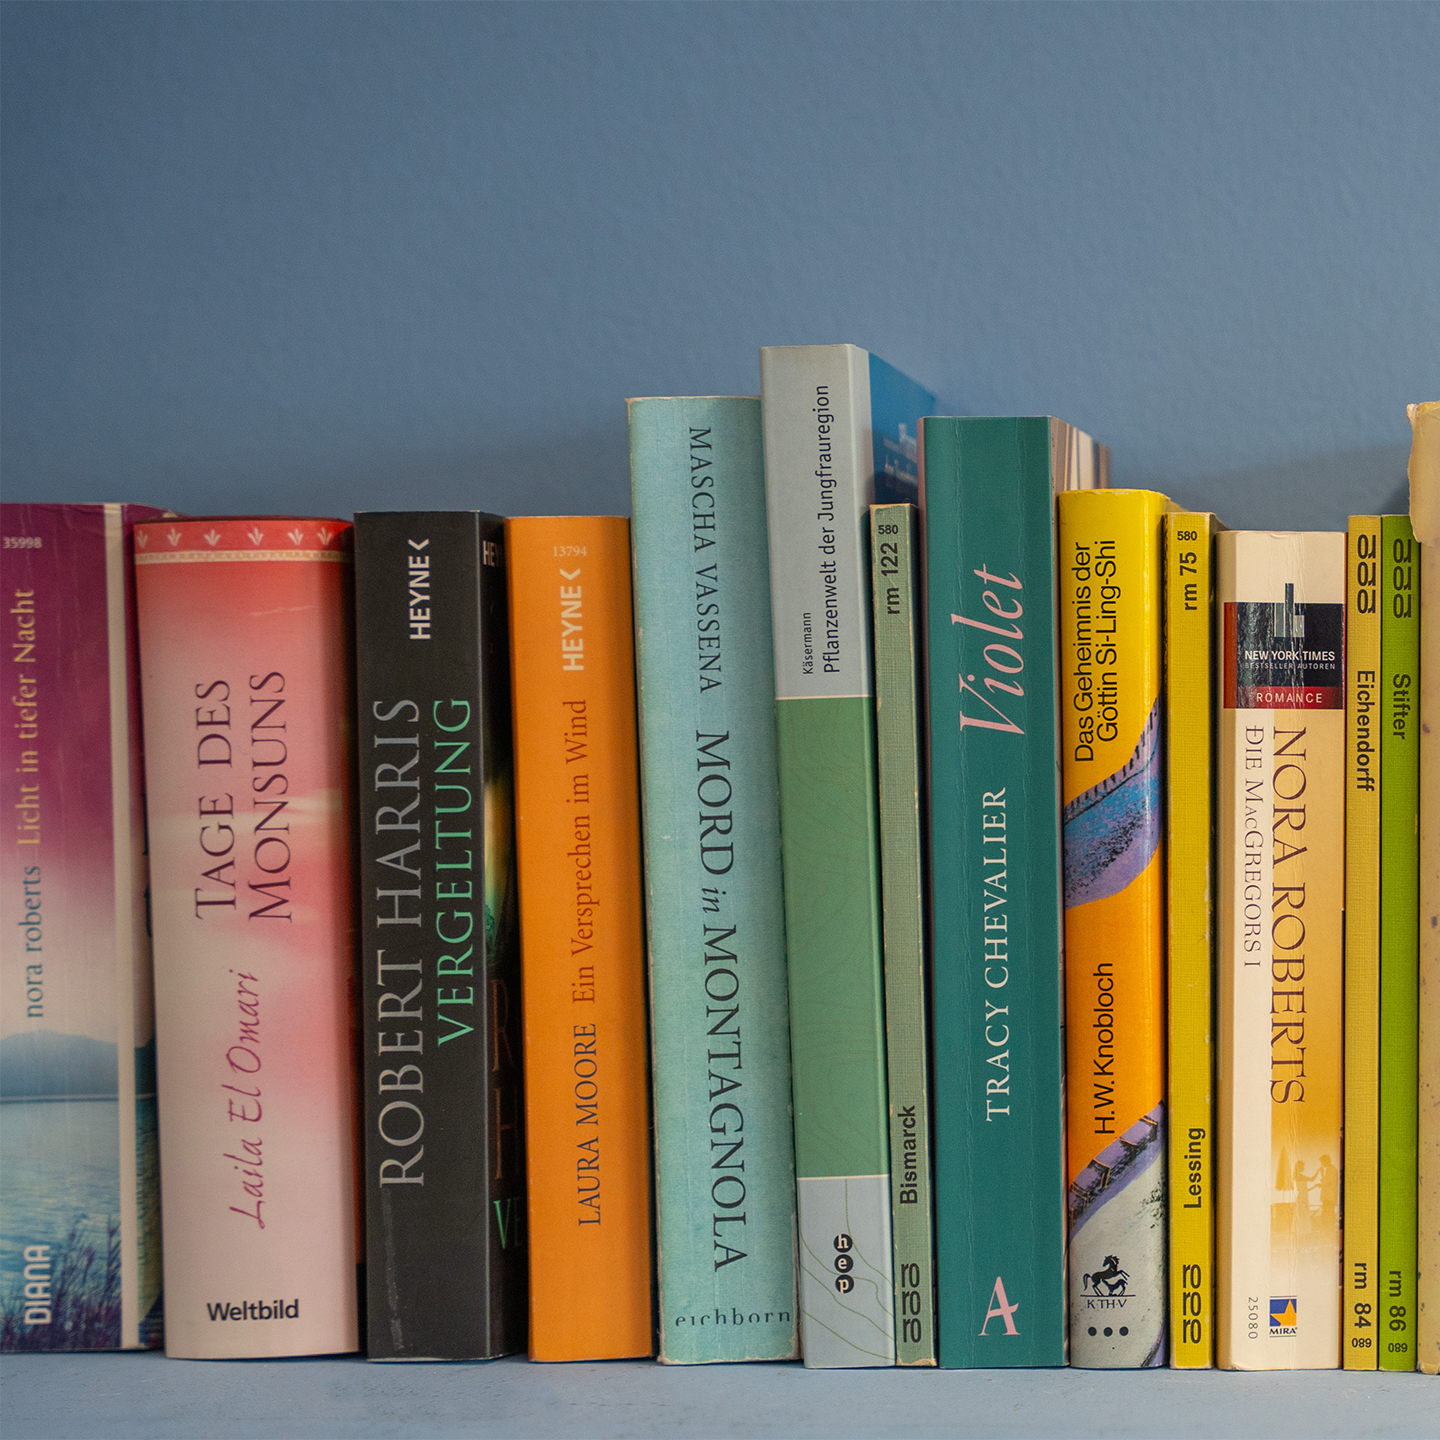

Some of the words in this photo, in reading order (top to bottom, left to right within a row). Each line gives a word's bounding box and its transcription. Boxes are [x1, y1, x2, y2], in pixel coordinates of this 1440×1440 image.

[813, 385, 837, 522] Jungfrauregion
[689, 427, 716, 552] MASCHA
[3, 537, 42, 549] 35998
[553, 546, 587, 557] 13794
[818, 526, 835, 555] der
[878, 525, 899, 535] 580
[880, 542, 899, 577] 122
[1072, 542, 1091, 581] der
[1177, 531, 1198, 541] 580
[1179, 551, 1198, 576] 75
[10, 588, 37, 663] Nacht
[695, 563, 722, 693] VASSENA
[820, 561, 840, 673] Pflanzenwelt
[887, 587, 900, 616] rm
[1095, 540, 1121, 665] Si-Ling-Shi
[1184, 583, 1198, 611] rm
[803, 612, 812, 675] Käsermann
[951, 563, 1025, 735] Violet
[1073, 589, 1093, 712] Geheimnis
[1244, 651, 1269, 661] NEW
[1271, 651, 1300, 661] YORK
[1302, 651, 1336, 661] TIMES
[13, 673, 38, 739] tiefer
[195, 680, 232, 769] DES
[1096, 670, 1119, 742] Göttin
[1256, 693, 1323, 704] ROMANCE
[1356, 670, 1375, 792] Eichendorff
[1392, 673, 1412, 740] Stifter
[16, 750, 39, 774] in
[563, 699, 588, 765] Wind
[1075, 716, 1094, 762] Das
[1245, 725, 1264, 770] DIE
[17, 782, 40, 845] Licht
[248, 671, 292, 923] MONSUNS
[373, 699, 421, 928] HARRIS
[565, 773, 589, 803] im
[696, 730, 734, 875] MORD
[1272, 726, 1308, 869] NORA
[195, 792, 237, 920] TAGE
[433, 699, 474, 1047] VERGELTUNG
[566, 815, 599, 957] Versprechen
[982, 787, 1009, 989] CHEVALIER
[18, 866, 42, 953] roberts
[701, 887, 727, 914] in
[25, 963, 44, 1019] nora
[572, 965, 595, 1004] Ein
[1269, 882, 1307, 1103] ROBERTS
[226, 969, 262, 1074] Omari
[376, 950, 424, 1187] ROBERT
[573, 1023, 599, 1127] MOORE
[985, 1000, 1010, 1122] TRACY
[221, 1084, 262, 1123] El
[703, 924, 748, 1273] MONTAGNOLA
[223, 1137, 265, 1230] Laila
[577, 1136, 601, 1227] LAURA
[897, 1105, 918, 1205] Bismarck
[1184, 1127, 1206, 1209] Lessing
[23, 1245, 52, 1325] DIANA
[1354, 1263, 1367, 1289] rm
[1389, 1270, 1401, 1298] rm
[207, 1299, 299, 1322] Weltbild
[675, 1308, 790, 1327] eichborn
[1248, 1297, 1258, 1339] 25080
[1351, 1338, 1372, 1348] 680
[1354, 1303, 1372, 1328] 84
[1389, 1305, 1407, 1332] 86
[1388, 1343, 1408, 1352] 680
